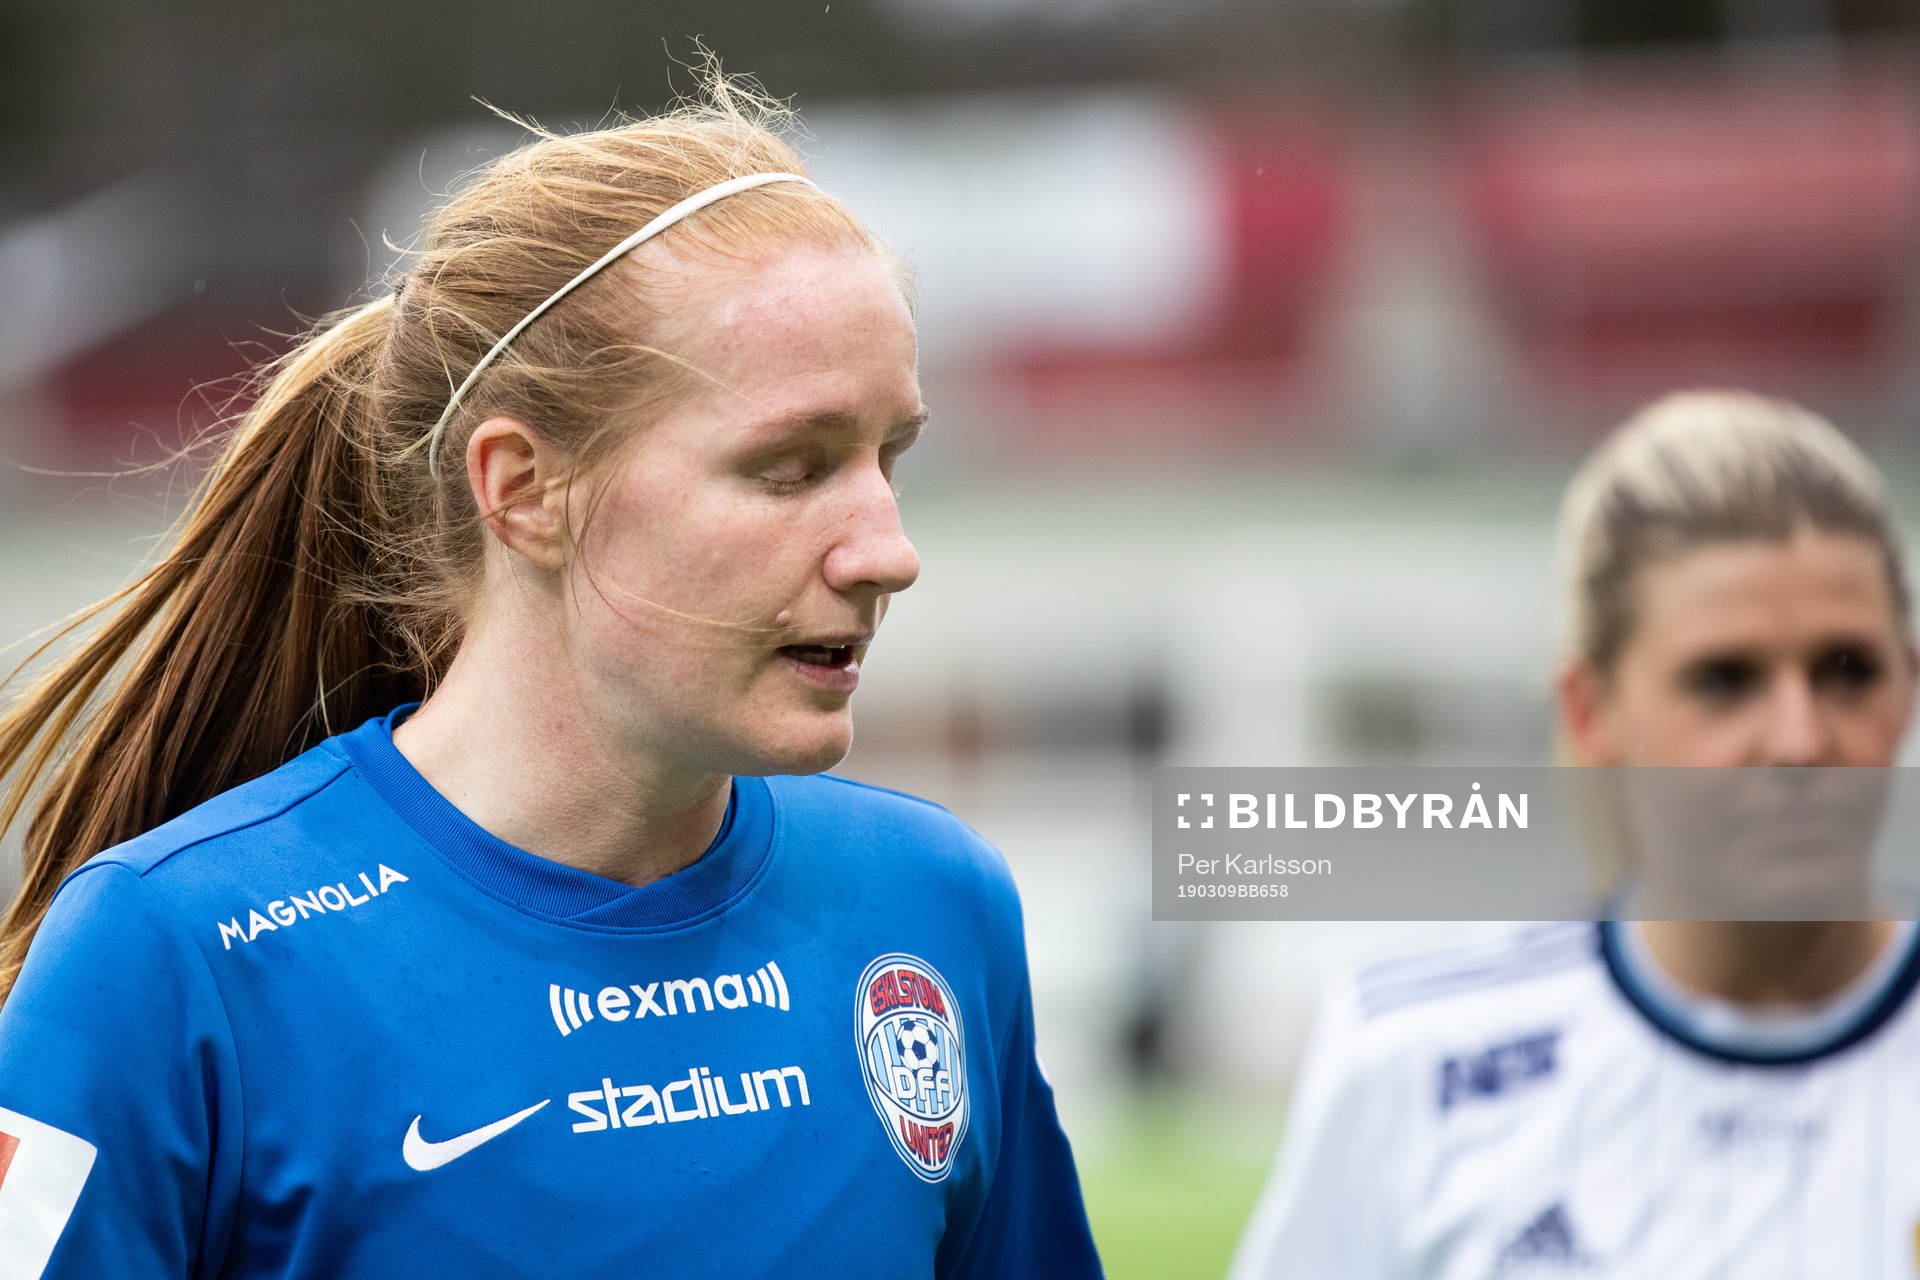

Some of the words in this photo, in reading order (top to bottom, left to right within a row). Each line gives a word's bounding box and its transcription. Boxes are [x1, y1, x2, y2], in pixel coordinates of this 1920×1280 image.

[217, 863, 409, 950] MAGNOLIA
[597, 974, 749, 1022] exma
[869, 969, 949, 1022] ESKILSTUNA
[567, 1066, 811, 1134] stadium
[891, 1065, 951, 1101] DFF
[899, 1114, 954, 1167] UNITED
